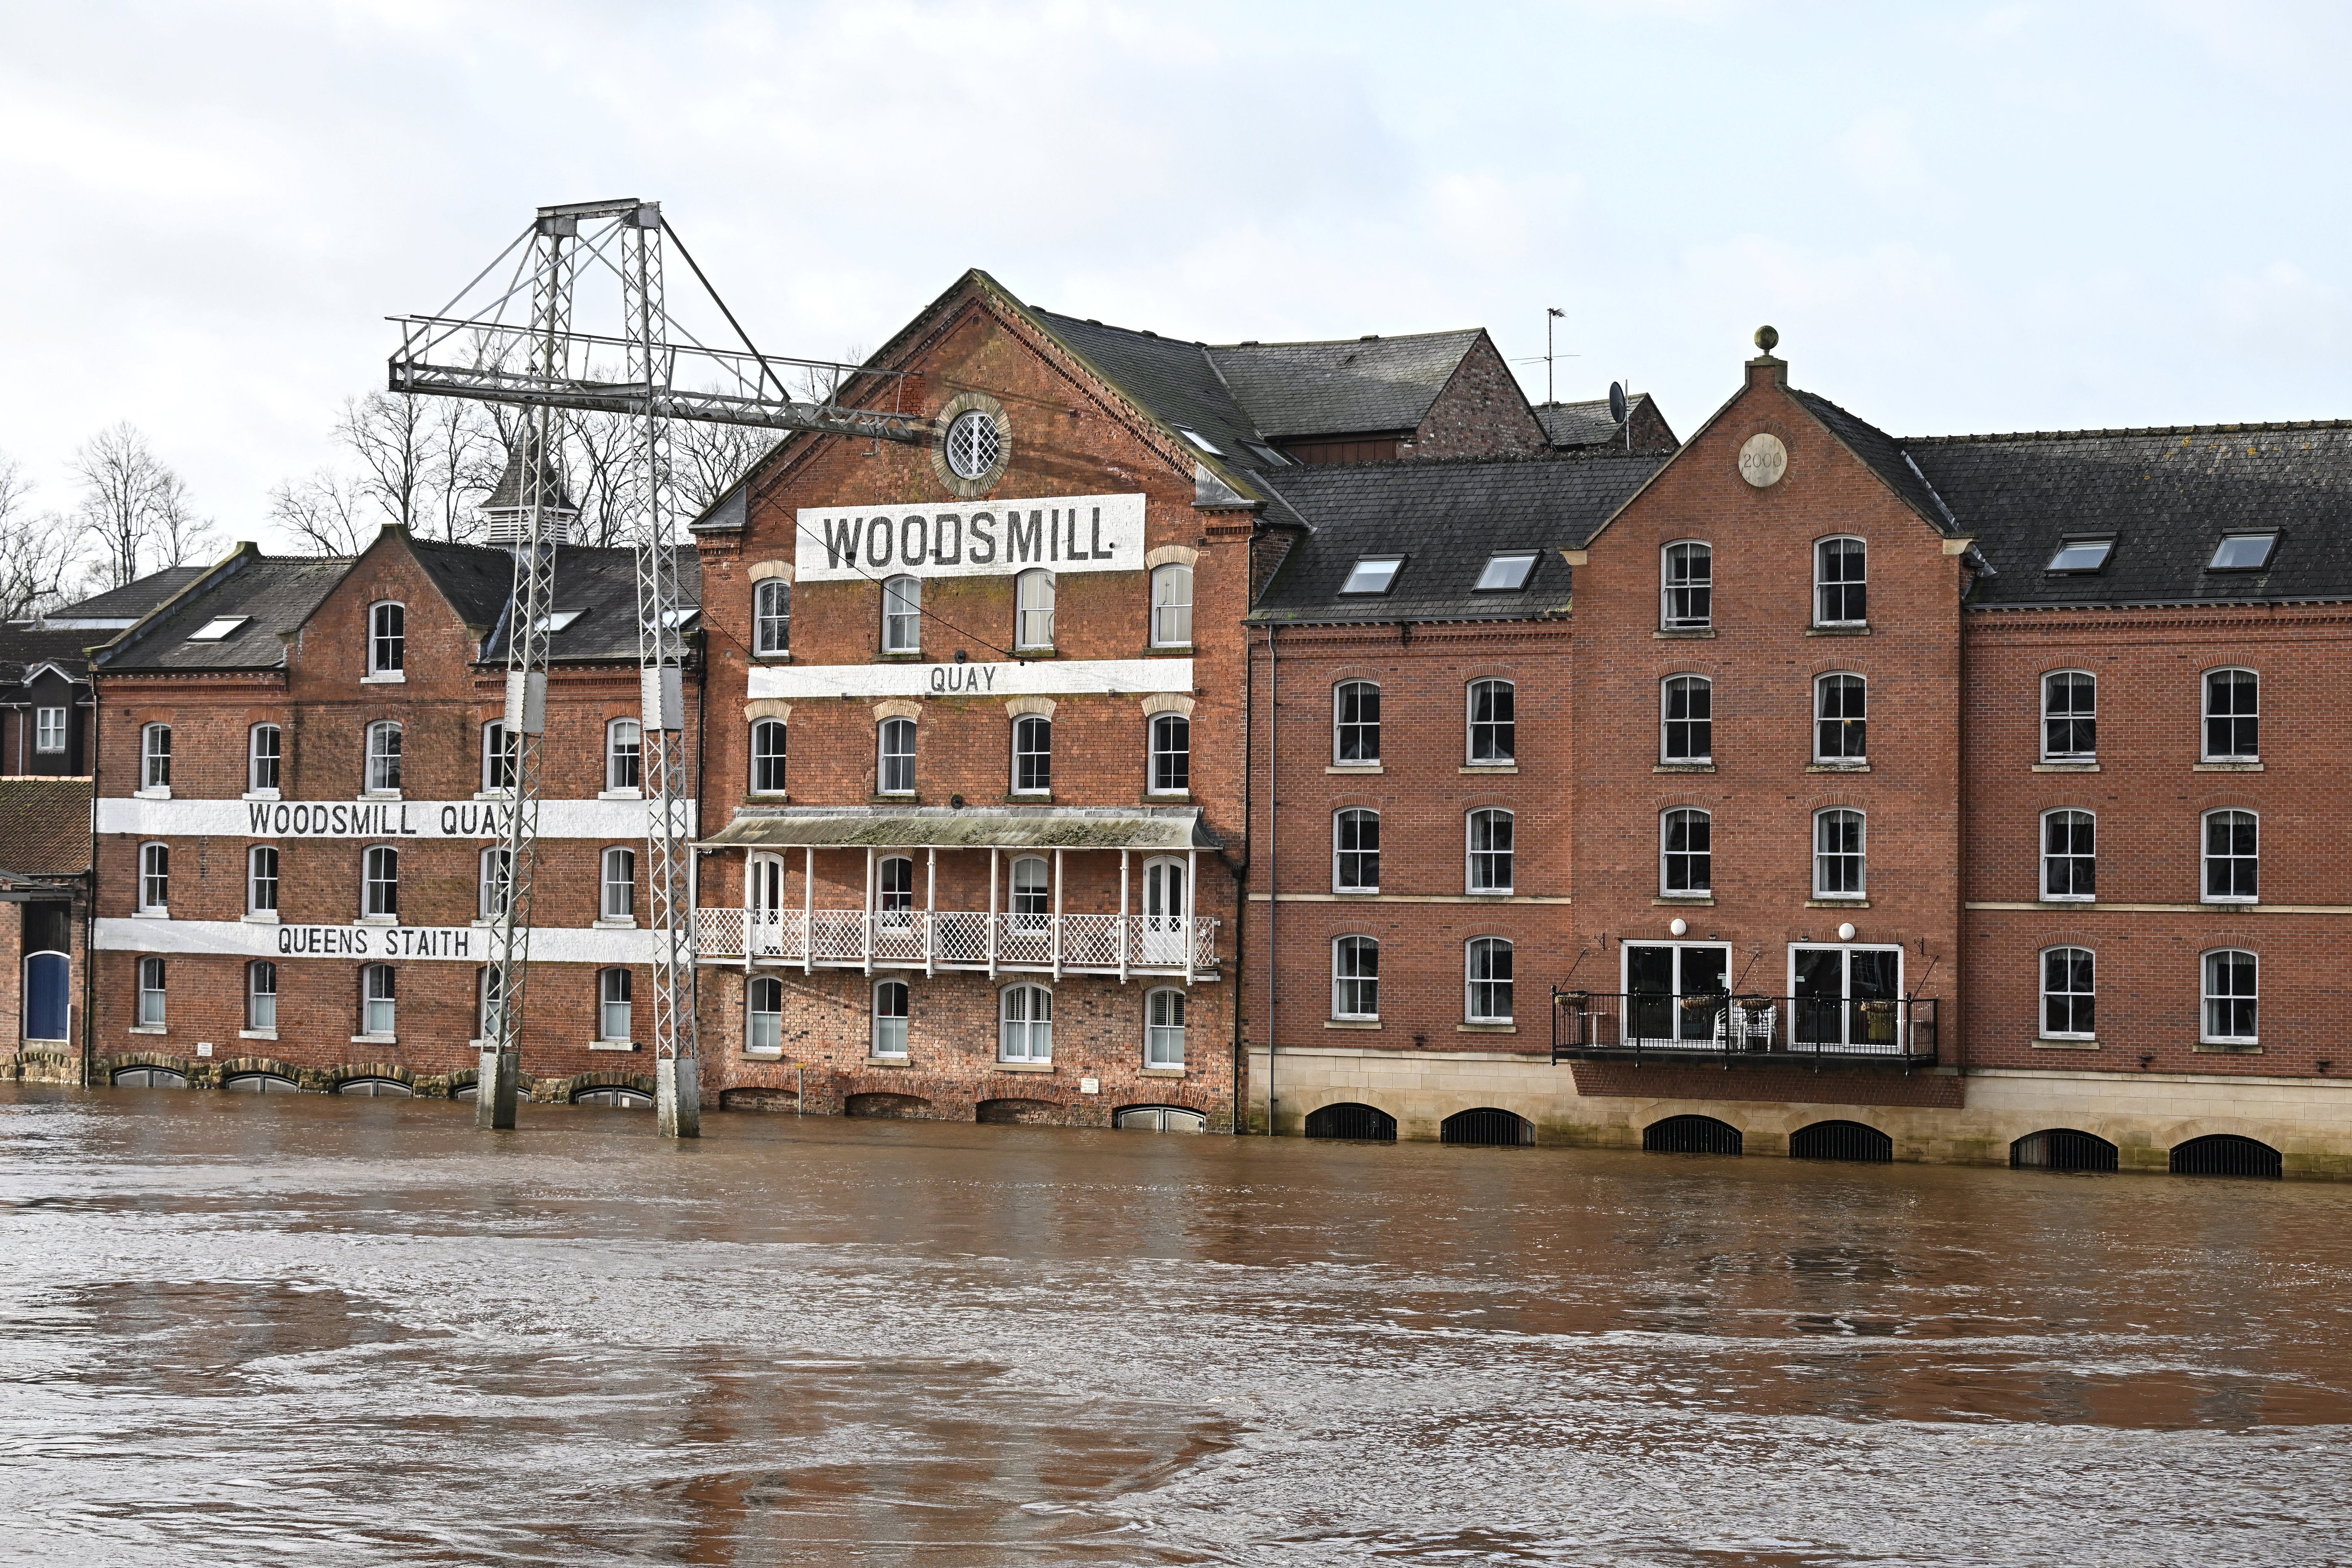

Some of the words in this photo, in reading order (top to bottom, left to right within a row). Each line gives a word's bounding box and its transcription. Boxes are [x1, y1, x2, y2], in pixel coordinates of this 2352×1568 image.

[1744, 453, 1781, 468] 2000
[824, 507, 1113, 569] WOODSMILL
[931, 666, 996, 692] QUAY
[249, 803, 417, 834] WOODSMILL
[441, 805, 515, 835] QUAY
[278, 928, 368, 954] QUEENS
[385, 929, 468, 956] STAITH
